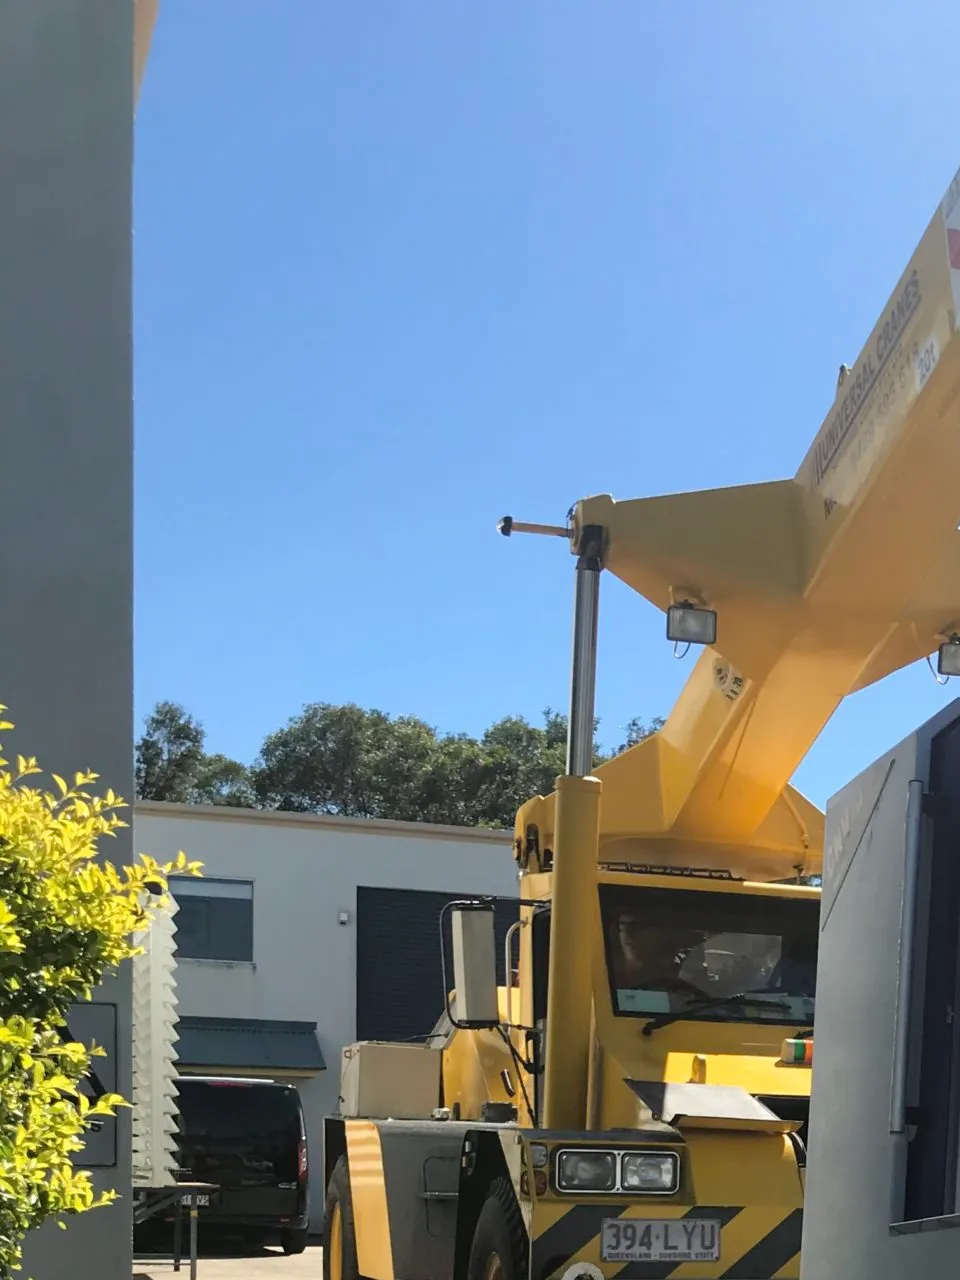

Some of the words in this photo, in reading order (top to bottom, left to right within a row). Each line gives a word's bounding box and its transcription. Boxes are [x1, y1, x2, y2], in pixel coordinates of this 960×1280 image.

[821, 355, 876, 462] UNIVERSAL
[876, 275, 920, 361] CRANES
[917, 341, 936, 383] 20t
